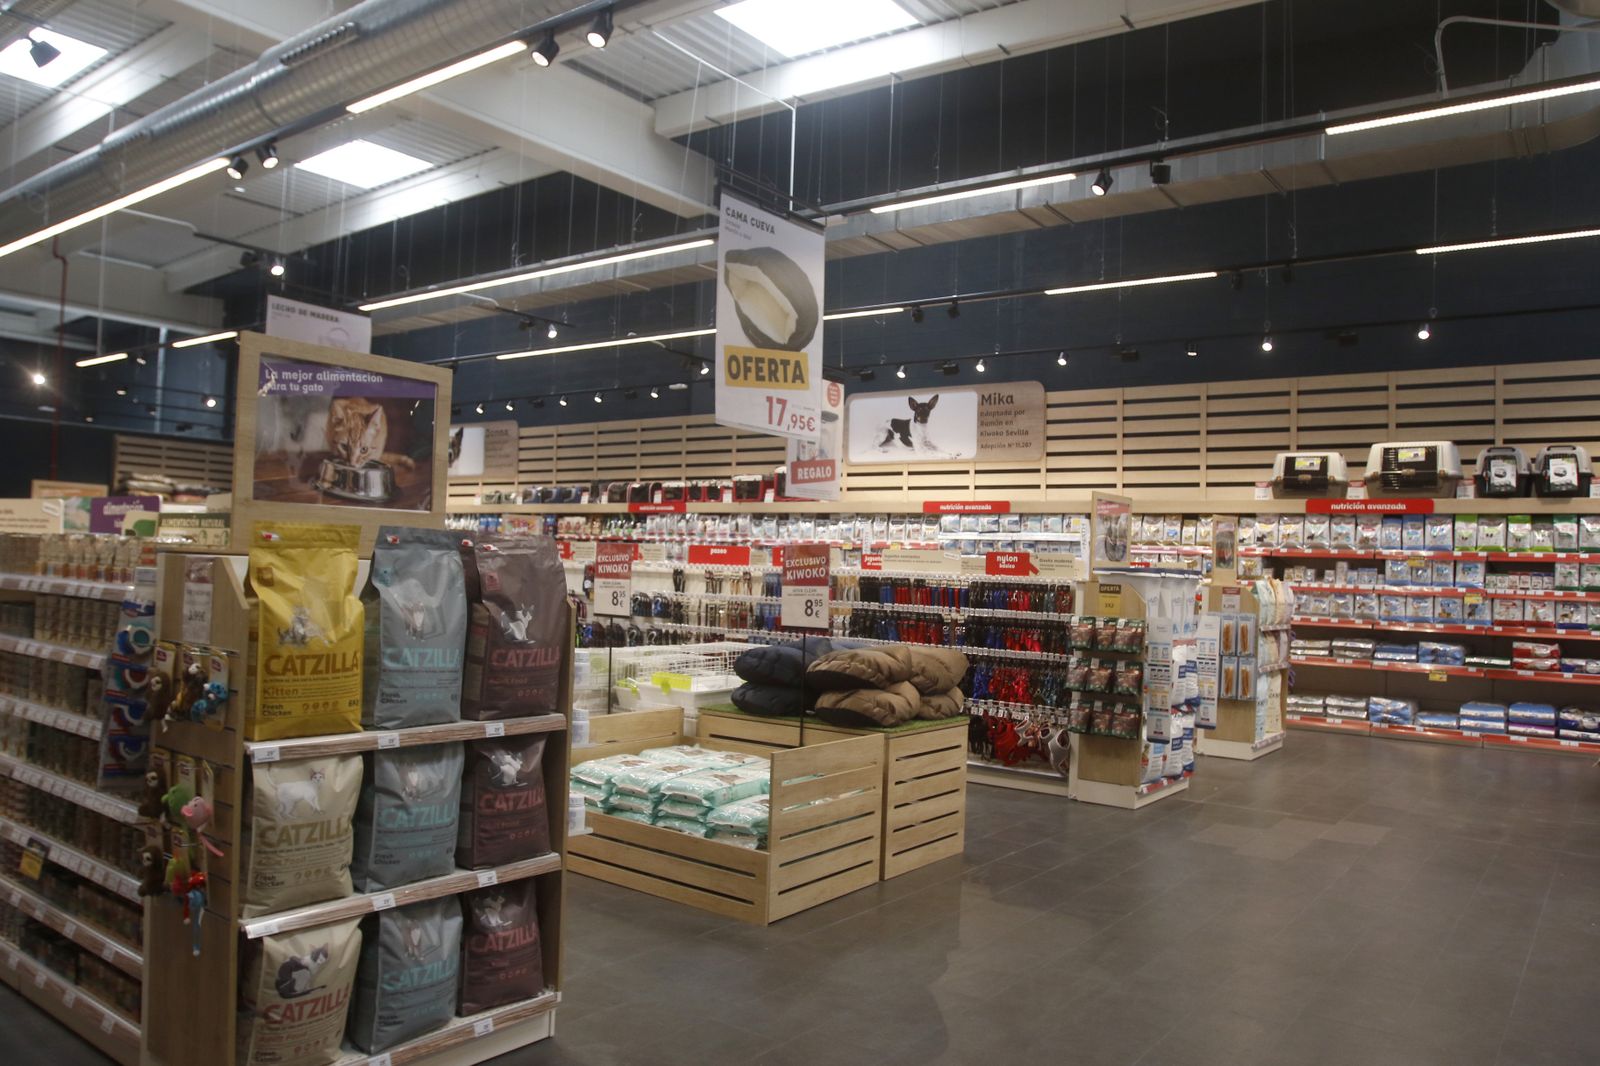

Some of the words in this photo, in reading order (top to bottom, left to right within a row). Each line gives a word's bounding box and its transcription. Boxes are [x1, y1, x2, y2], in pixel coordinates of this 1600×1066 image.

[725, 207, 748, 224] CAMA
[750, 217, 776, 235] CUEVA
[271, 303, 296, 314] LECHO
[298, 308, 308, 317] DE
[309, 310, 340, 323] MADERA
[727, 354, 805, 384] OFERTA
[282, 370, 313, 383] mejor
[289, 383, 300, 392] tu
[302, 384, 324, 394] gato
[981, 392, 1014, 406] Mika
[797, 465, 832, 480] REGALO
[940, 503, 964, 511] nutrición
[1331, 502, 1365, 510] nutrición
[1367, 503, 1406, 511] avanzada
[710, 548, 728, 556] paseo
[598, 554, 630, 563] EXCLUSIVO
[785, 556, 827, 568] EXCLUSIVO
[996, 554, 1018, 564] nylon
[598, 563, 629, 574] KIWOKO
[786, 567, 826, 580] KIWOKO
[1100, 585, 1120, 593] OFERTA
[612, 591, 619, 606] 8
[804, 599, 814, 617] 8
[814, 599, 823, 607] 95
[264, 651, 360, 677] CATZILLA
[262, 686, 299, 697] Kitten
